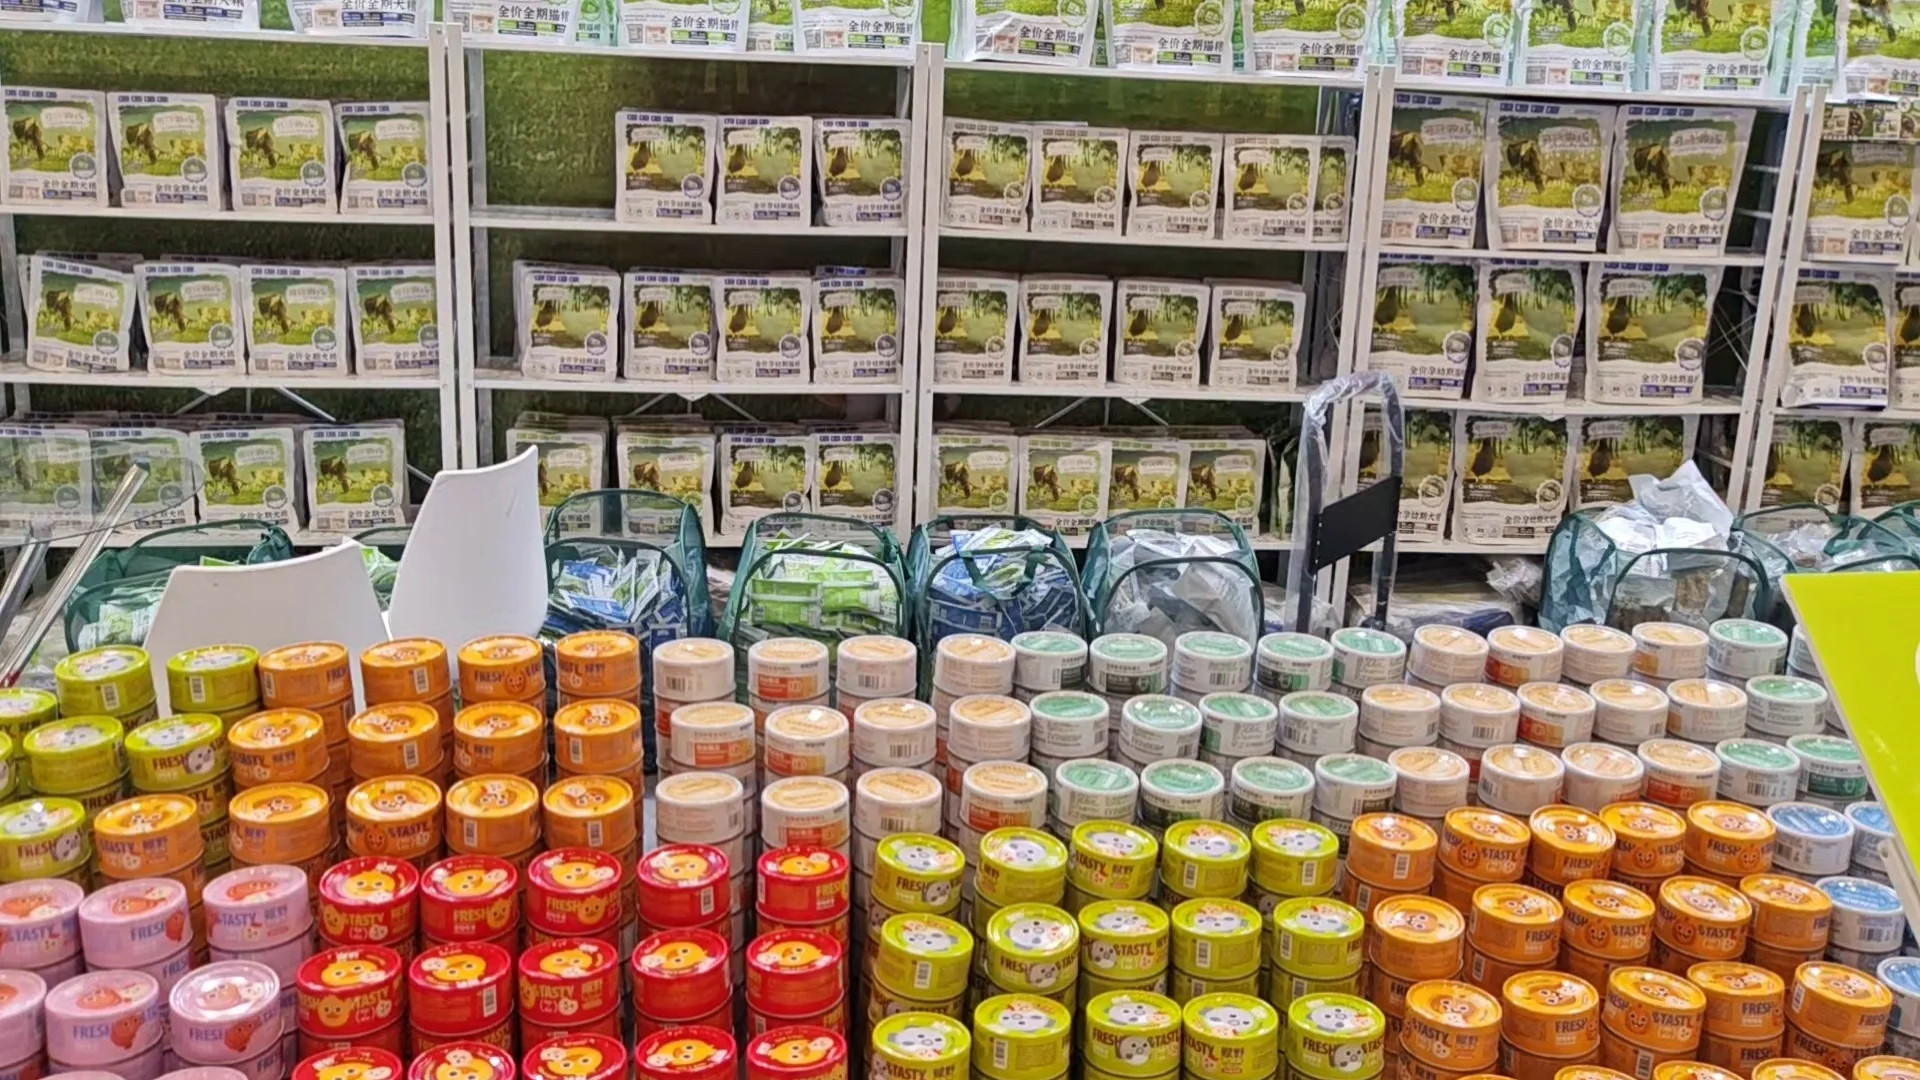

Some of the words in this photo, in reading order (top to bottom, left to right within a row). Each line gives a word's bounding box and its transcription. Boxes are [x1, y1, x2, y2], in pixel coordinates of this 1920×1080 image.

[1448, 48, 1504, 64] 全价全期猫
[1612, 924, 1648, 937] &TASTY
[1698, 924, 1736, 937] &TASTY
[1113, 943, 1154, 956] &TASTY
[1653, 1011, 1693, 1026] &TASTY
